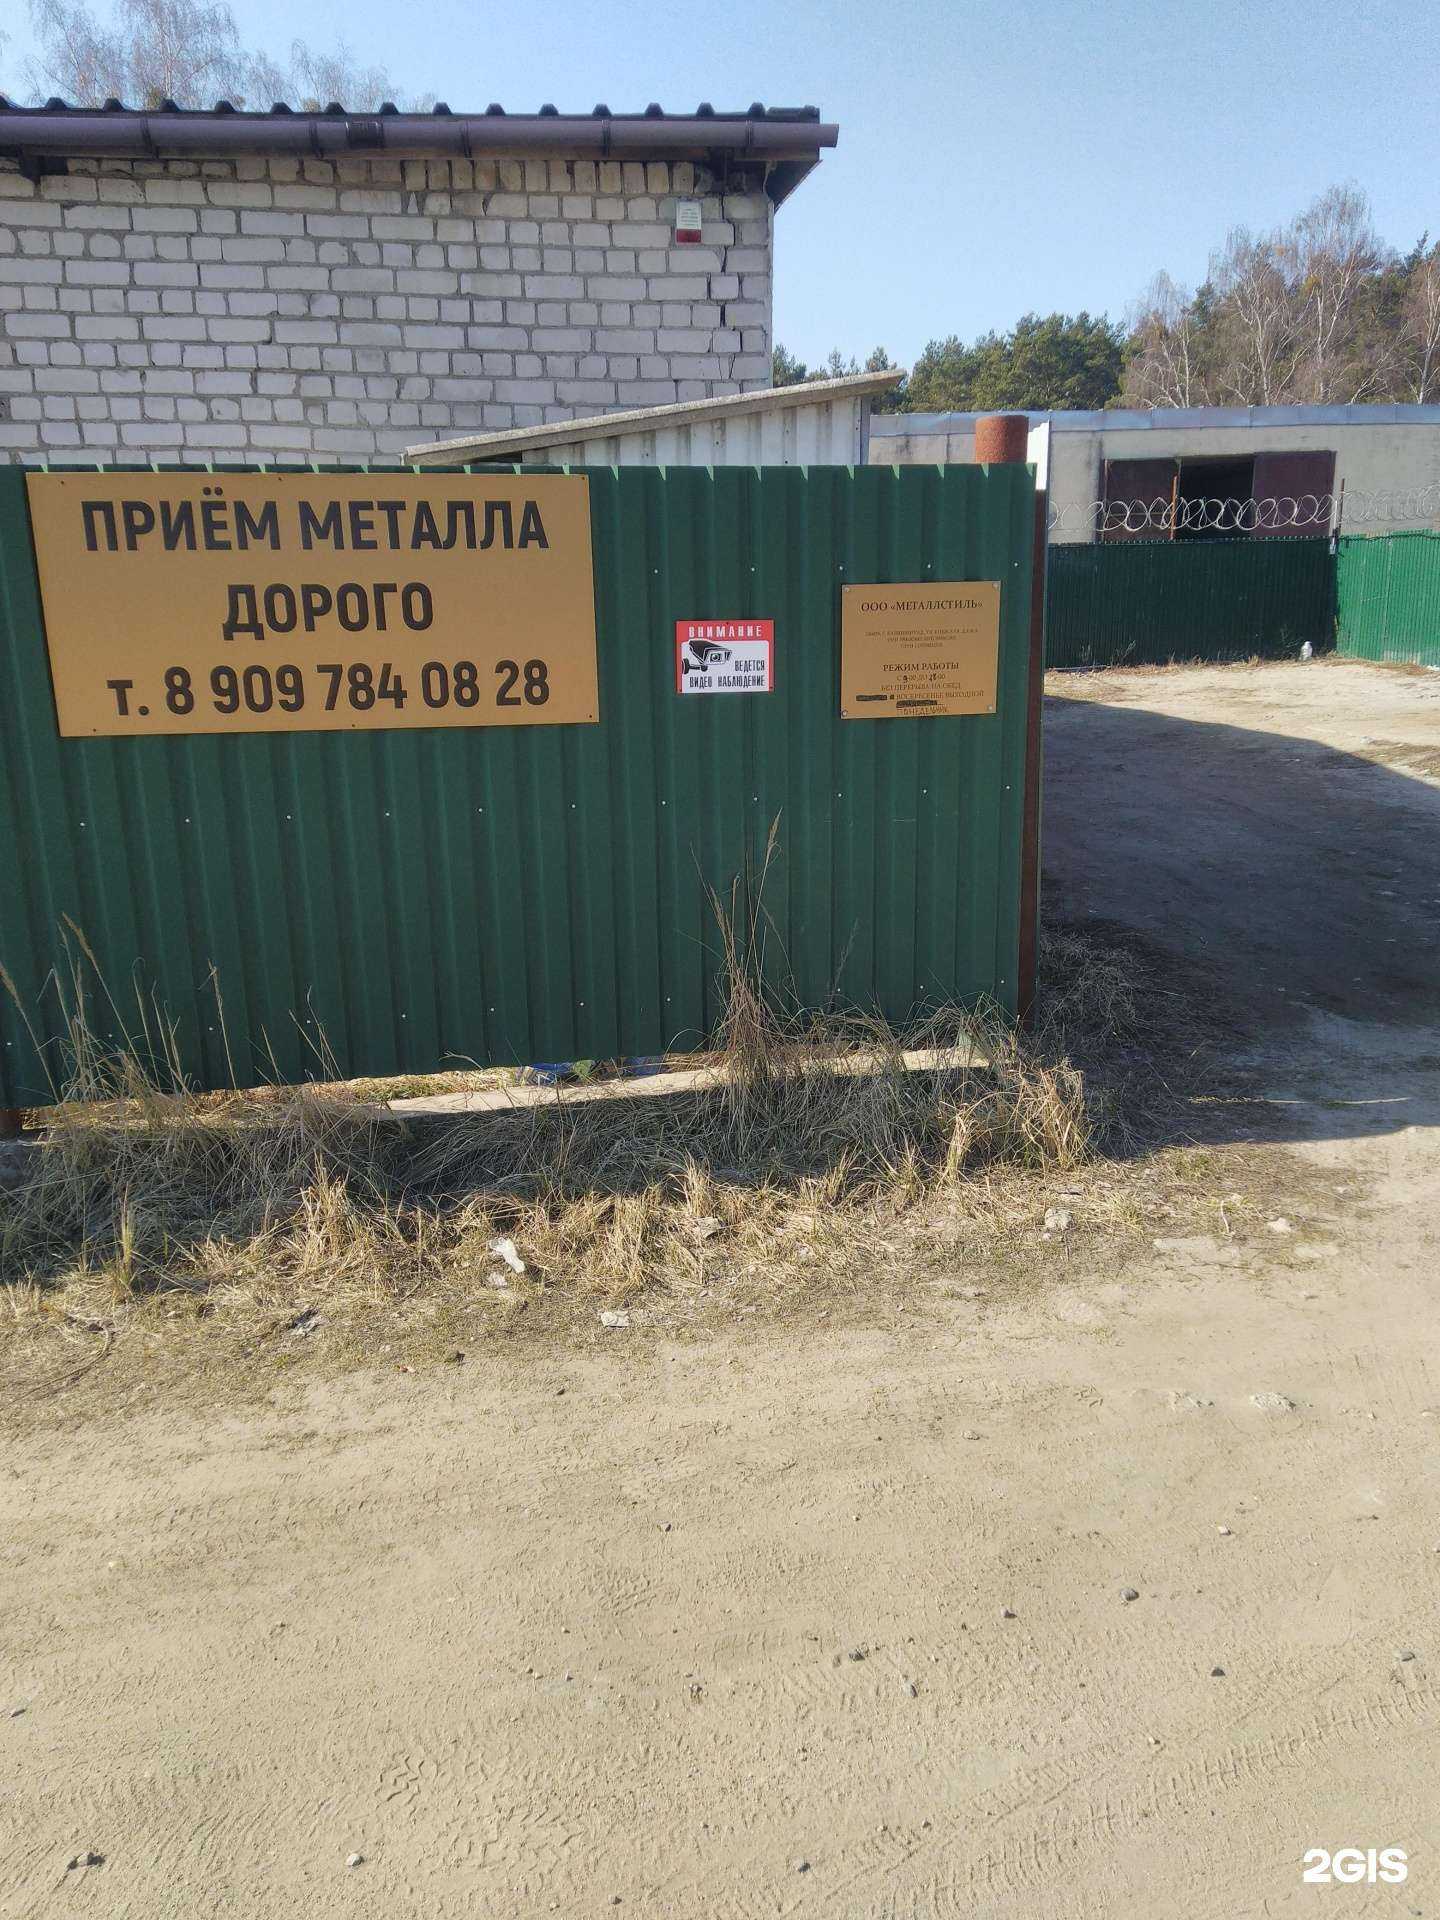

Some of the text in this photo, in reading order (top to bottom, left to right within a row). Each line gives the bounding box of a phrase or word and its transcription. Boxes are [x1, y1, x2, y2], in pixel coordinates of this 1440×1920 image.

[81, 486, 549, 551] ПРИЁМ МЕТАЛЛА
[222, 582, 434, 641] ДОРОГО
[861, 599, 983, 612] ООО «МЕТАЛЛСТИЛЬ»
[688, 625, 762, 638] ВНИМАНИЕ
[734, 659, 765, 672] ВЕДЕТСЯ
[882, 662, 960, 672] РЕЖИМ РАБОТЫ
[164, 666, 195, 716] 8
[210, 664, 305, 714] 909
[316, 662, 408, 711] 784
[421, 660, 480, 709] 08
[494, 658, 551, 706] 28
[689, 675, 765, 688] ВИДЕО НАБЛЮДЕНИЕ
